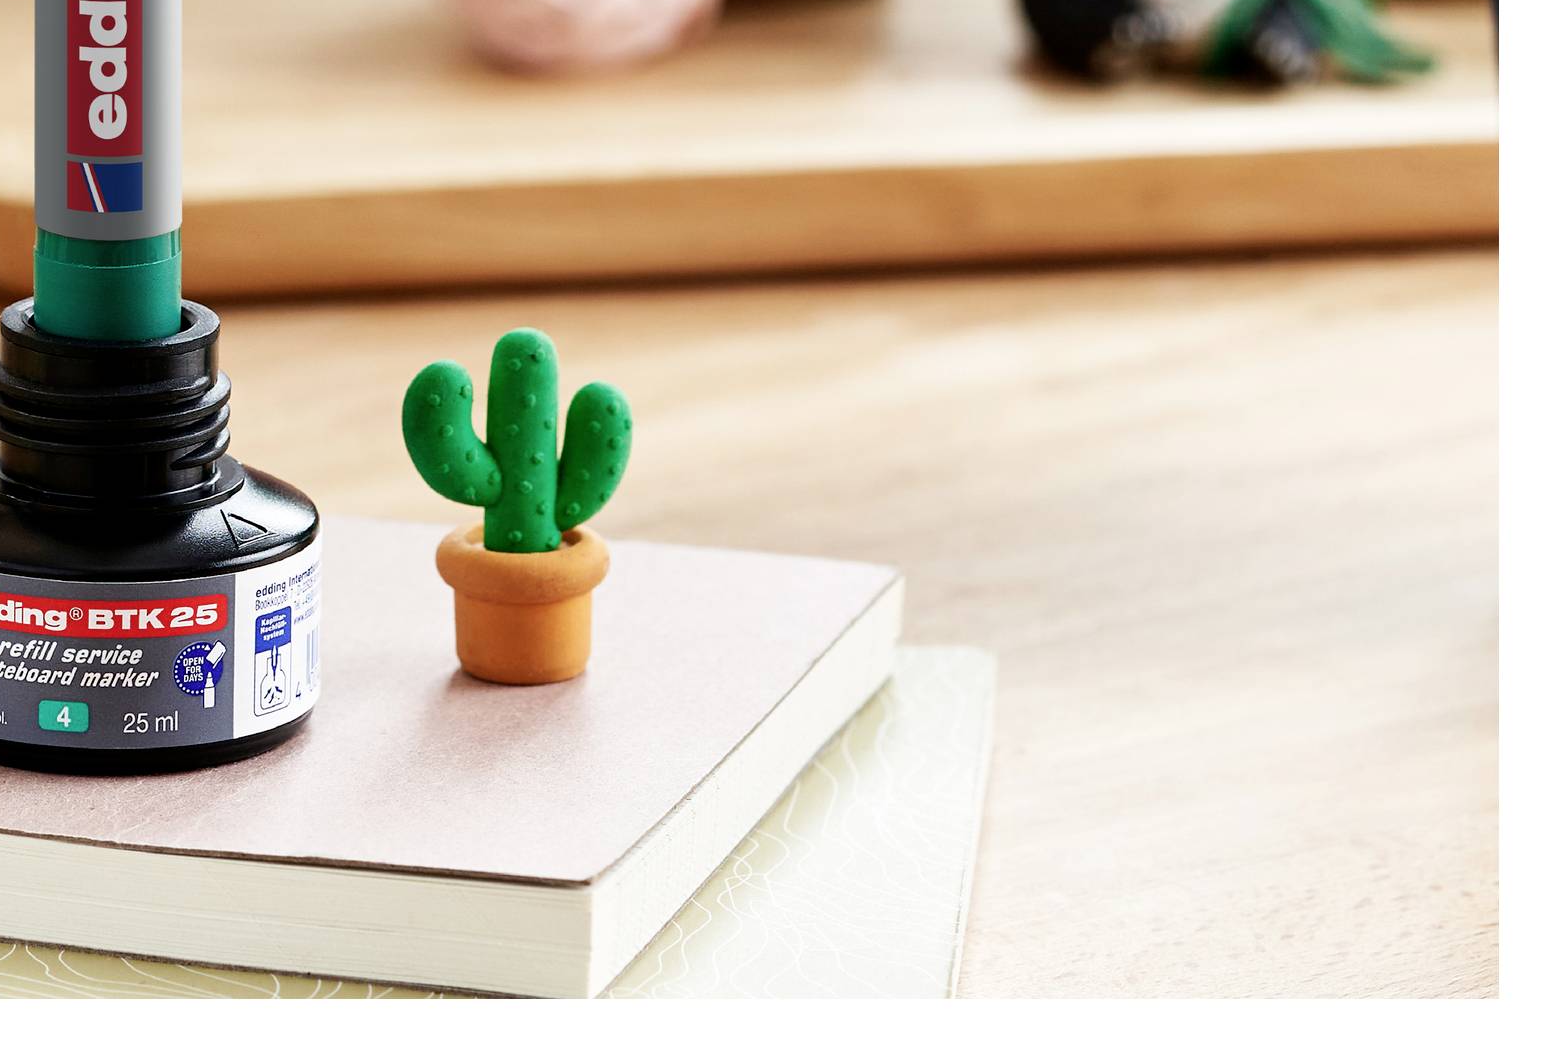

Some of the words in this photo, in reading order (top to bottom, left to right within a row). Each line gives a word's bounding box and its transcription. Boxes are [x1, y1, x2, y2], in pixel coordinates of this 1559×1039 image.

[255, 581, 287, 598] edding
[88, 608, 165, 630] BTK
[170, 603, 218, 628] 25
[61, 644, 143, 665] service
[183, 656, 204, 667] OPEN
[80, 668, 159, 688] marker
[183, 673, 204, 683] DAYS
[185, 665, 201, 674] FOR
[56, 706, 71, 728] 4
[123, 712, 149, 733] 25
[155, 710, 179, 732] ml
